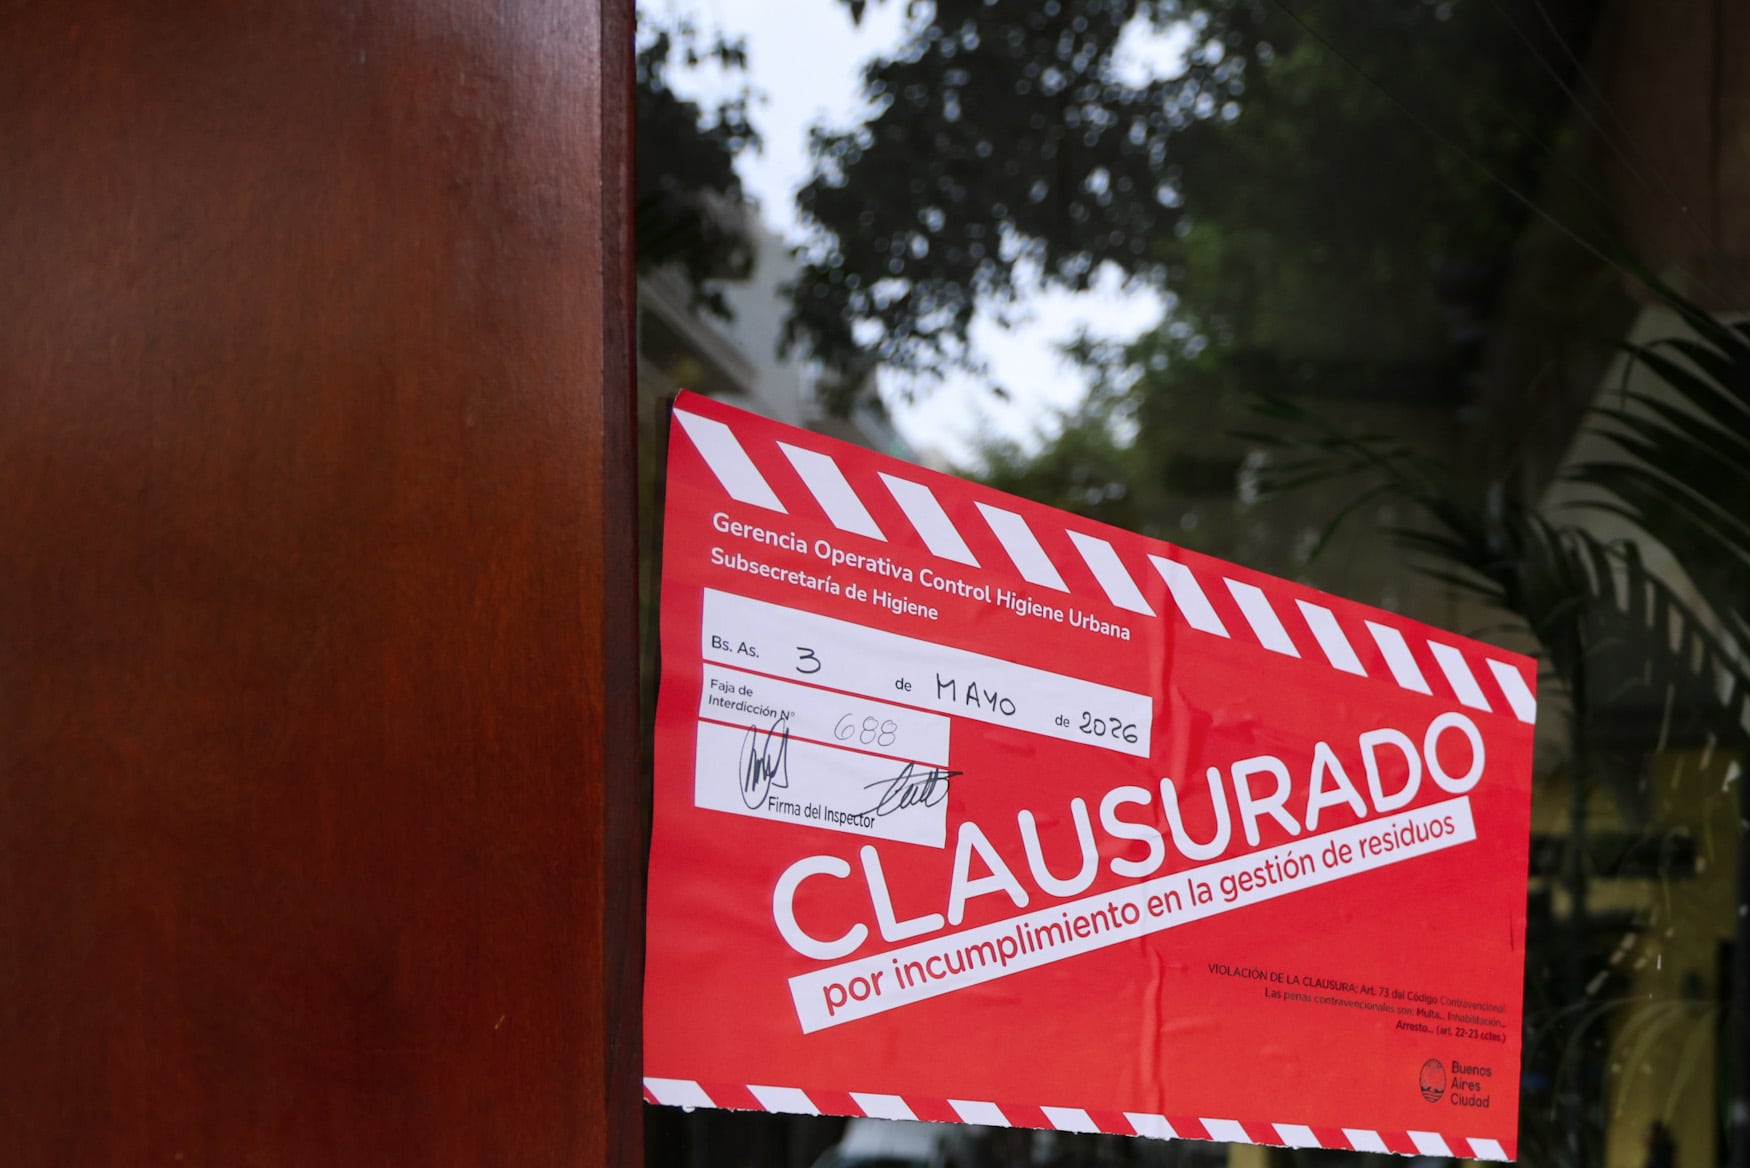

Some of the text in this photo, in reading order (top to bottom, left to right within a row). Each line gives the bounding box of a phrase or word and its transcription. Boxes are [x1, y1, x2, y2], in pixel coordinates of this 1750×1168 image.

[711, 548, 938, 620] Subsecretaría de Higiene
[712, 512, 1130, 640] Gerencia Operativa Control Higiene Urbana
[710, 678, 753, 697] Faja de
[712, 635, 1138, 744] Bs. As. 3 de MAYO de 2026
[708, 695, 777, 718] Interdicción
[834, 713, 898, 746] 688
[768, 796, 875, 828] Firma del Inspector
[772, 711, 1485, 961] CLAUSURADO
[822, 812, 1456, 1016] por incumplimiento en la gestión de residuos
[1208, 964, 1268, 980] VIOLACIÓN
[1270, 972, 1284, 983] DE
[1286, 975, 1300, 985] LA
[1360, 984, 1376, 996] Art.
[1378, 987, 1390, 998] 73
[1392, 988, 1404, 998] del
[1407, 991, 1438, 1006] Código
[1265, 988, 1281, 999] Las
[1284, 990, 1312, 1002] penas
[1455, 1026, 1478, 1039] 22-23
[1450, 1077, 1481, 1092] Aires
[1452, 1060, 1492, 1077] Buenos
[1450, 1093, 1490, 1108] Ciudad
